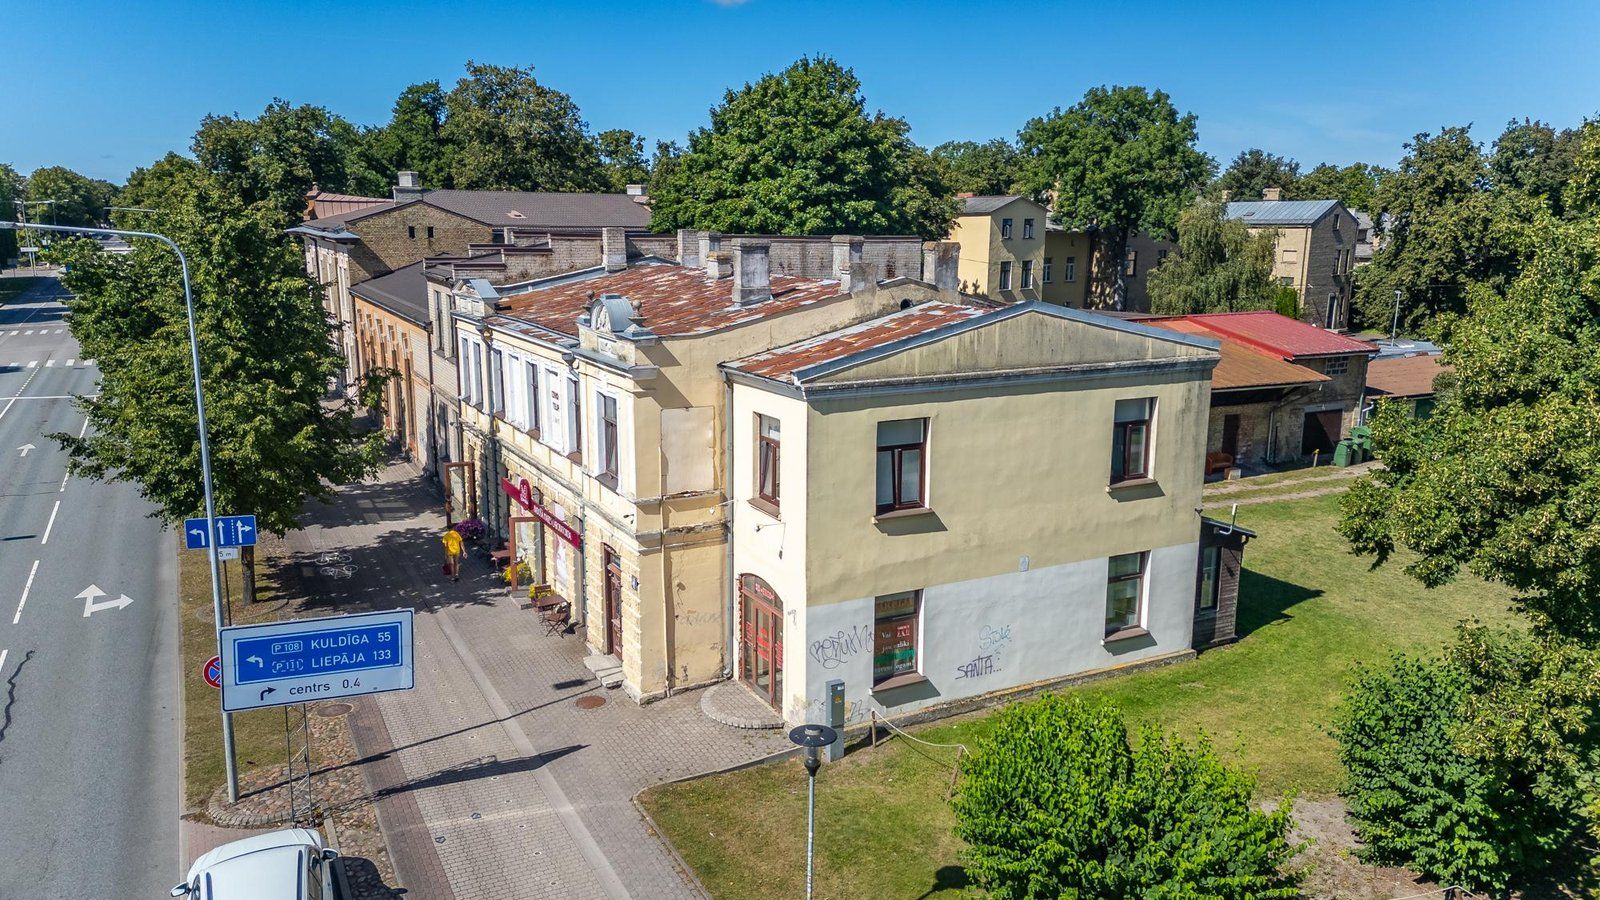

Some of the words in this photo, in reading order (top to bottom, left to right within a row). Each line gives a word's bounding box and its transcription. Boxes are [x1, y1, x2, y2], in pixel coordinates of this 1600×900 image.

[310, 633, 370, 650] KULDĪGA
[377, 631, 391, 642] 55
[311, 652, 366, 668] LIEPĀJA
[372, 649, 391, 661] 133
[289, 682, 331, 695] centrs
[342, 677, 361, 690] 0.4
